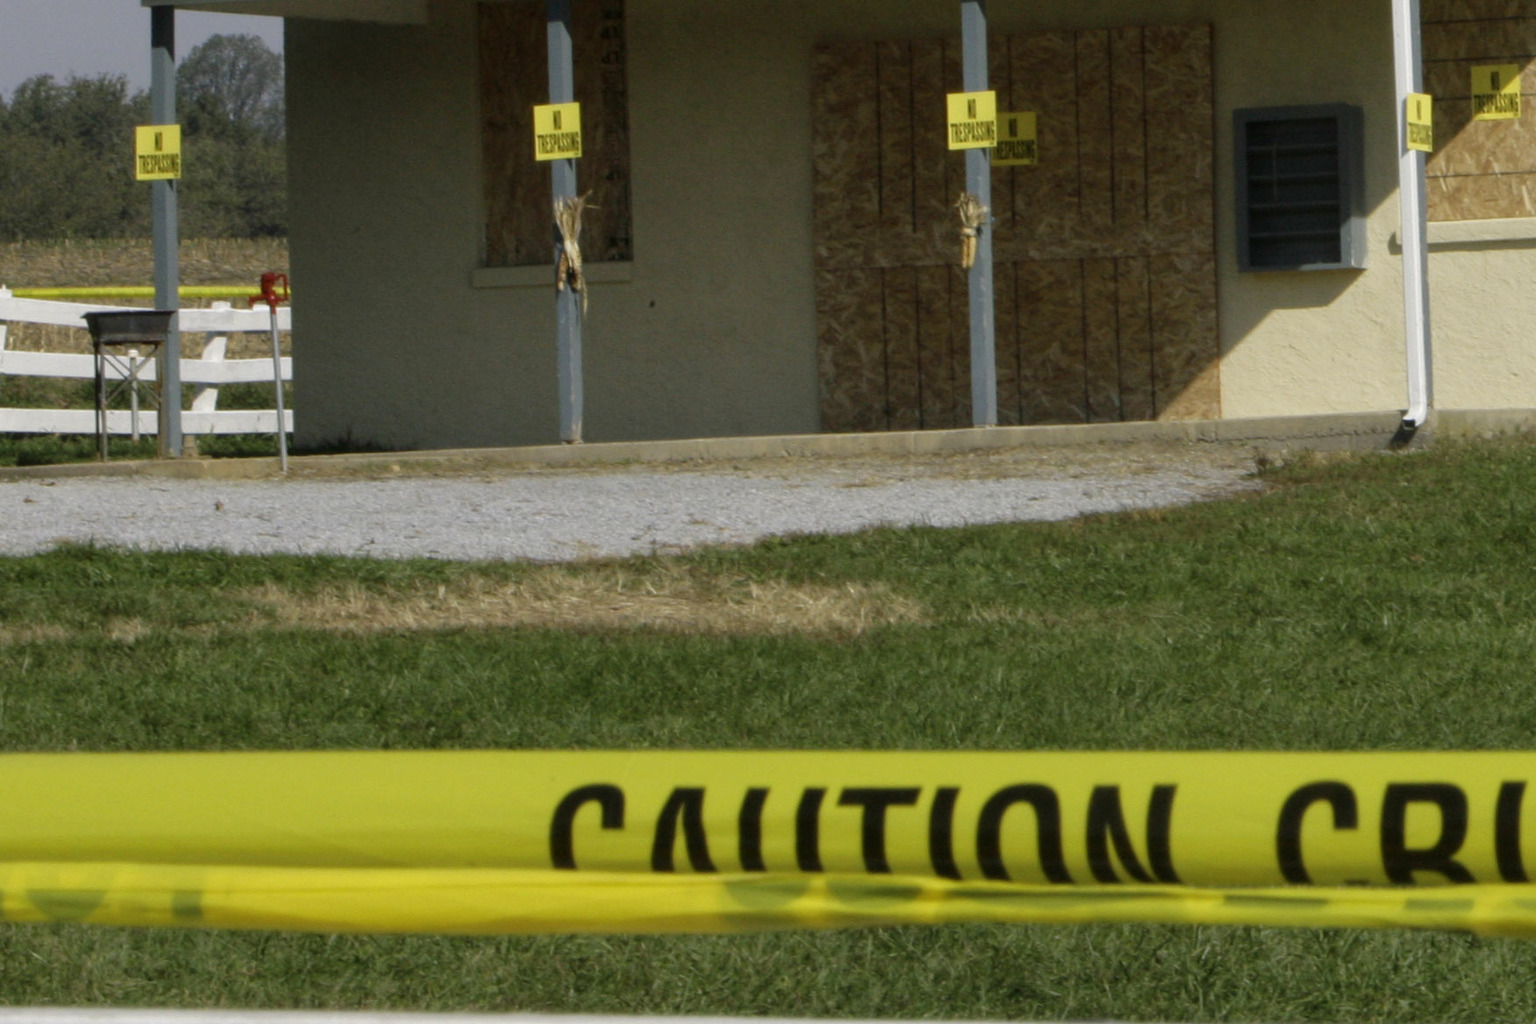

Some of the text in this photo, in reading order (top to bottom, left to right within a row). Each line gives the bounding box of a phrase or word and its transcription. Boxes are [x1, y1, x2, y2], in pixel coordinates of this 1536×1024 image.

[968, 98, 976, 119] NO
[553, 110, 561, 130] NO
[154, 132, 163, 152] NO
[537, 132, 579, 154] TRESPASSING
[950, 121, 995, 144] TRESPASSING
[138, 153, 180, 174] TRESPASSING
[548, 784, 1186, 884] CAUTION
